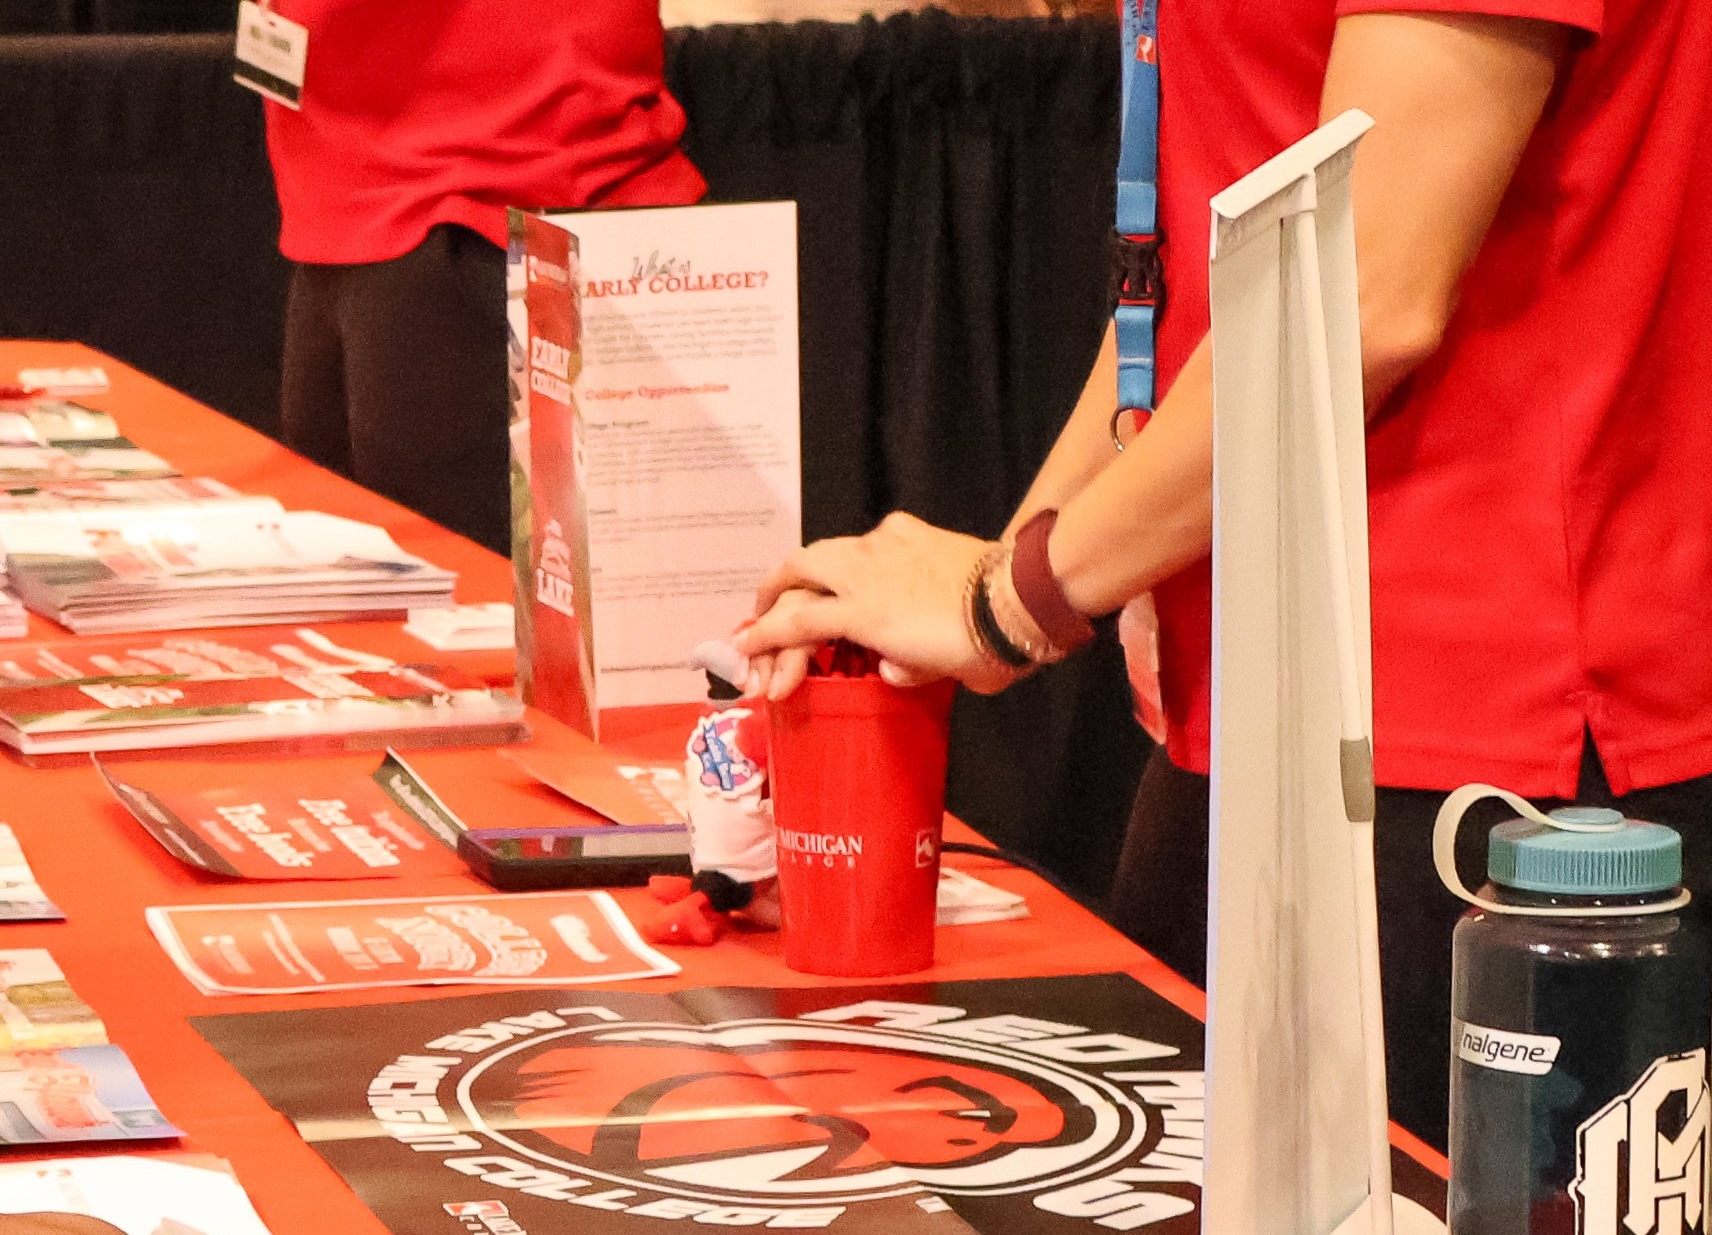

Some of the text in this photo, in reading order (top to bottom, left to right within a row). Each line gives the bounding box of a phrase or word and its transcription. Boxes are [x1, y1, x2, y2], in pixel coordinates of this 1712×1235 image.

[583, 269, 769, 299] ARLY COLLEGE?
[799, 999, 1182, 1064] RED
[1462, 1032, 1554, 1063] nalgene
[367, 1006, 848, 1229] LAKE MICHIGAN COLLEGE
